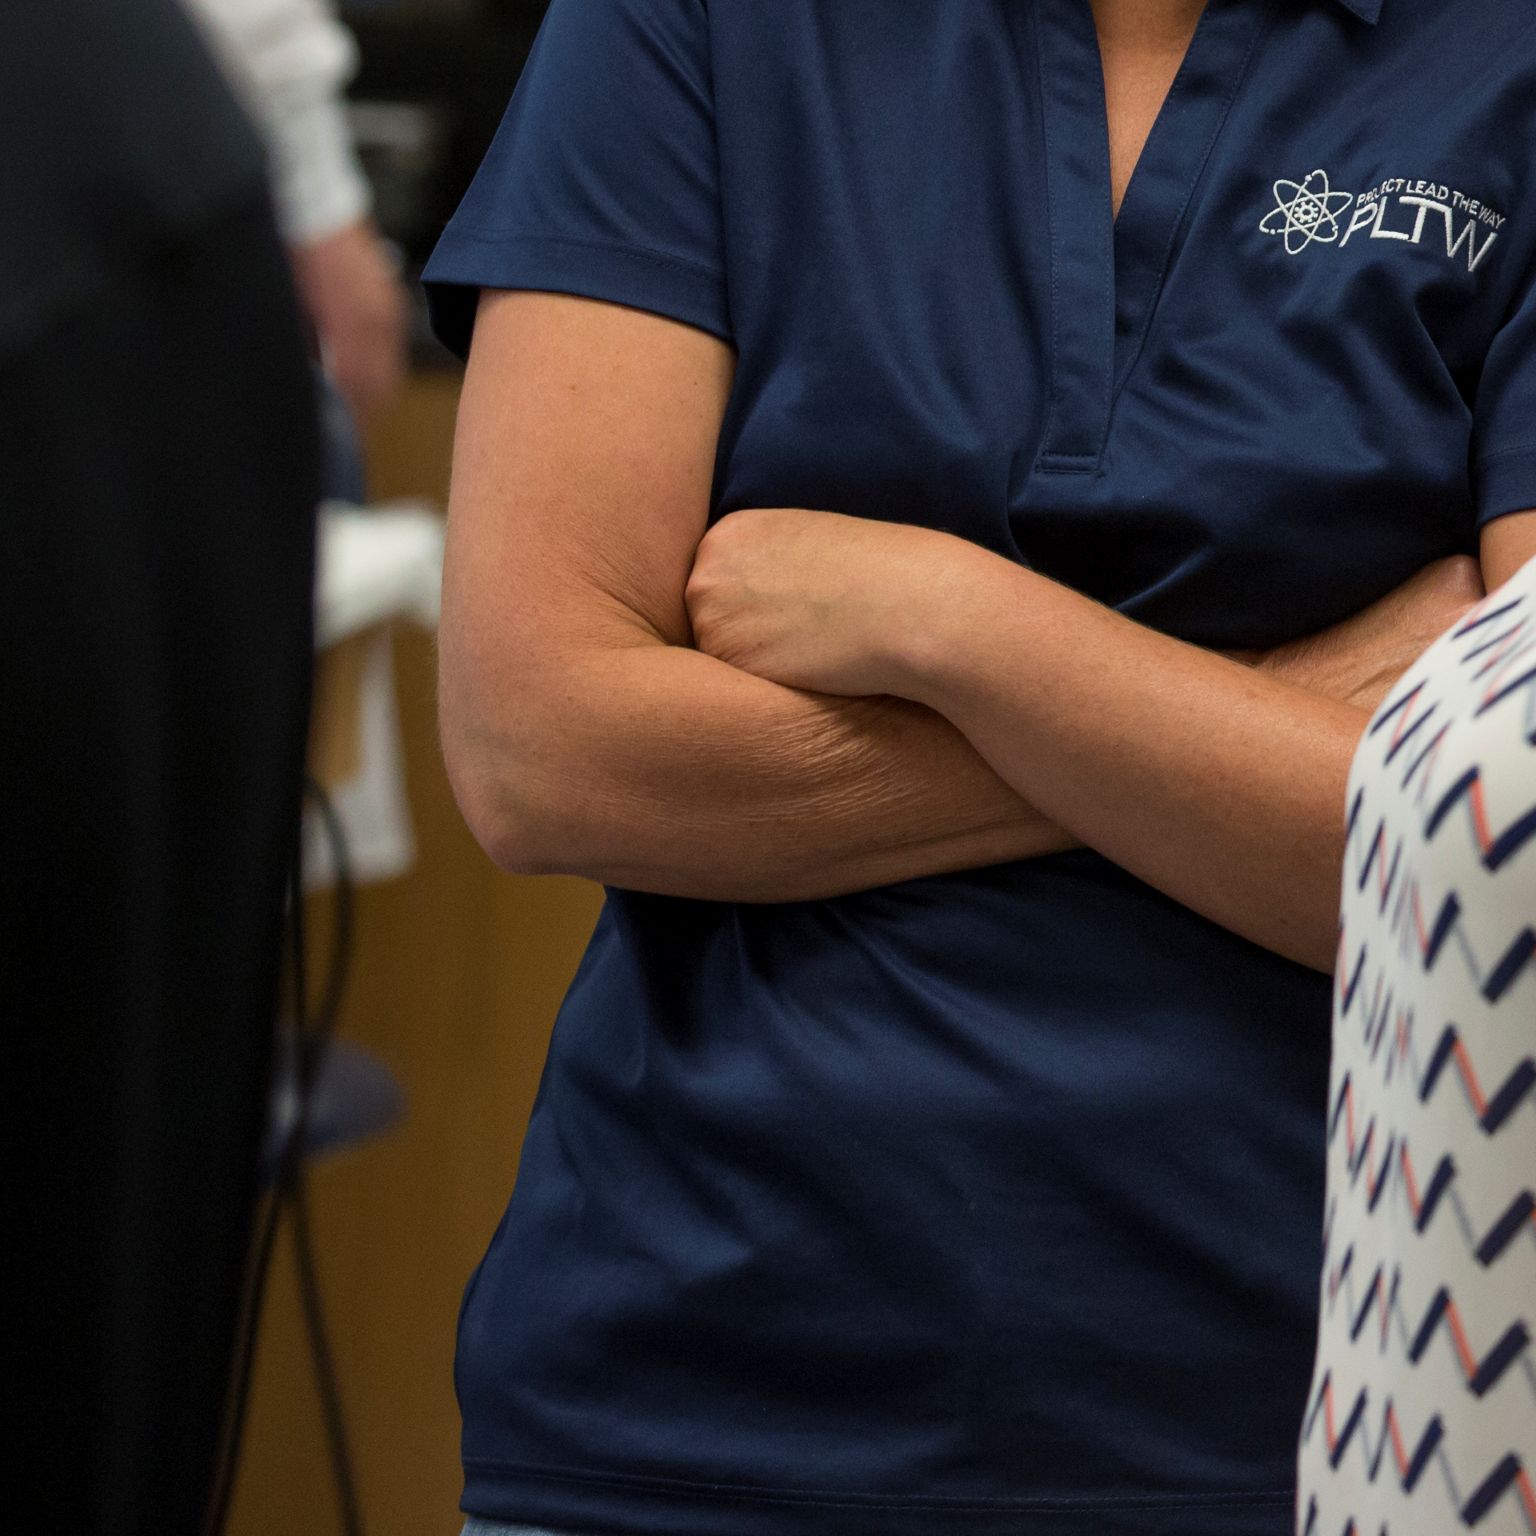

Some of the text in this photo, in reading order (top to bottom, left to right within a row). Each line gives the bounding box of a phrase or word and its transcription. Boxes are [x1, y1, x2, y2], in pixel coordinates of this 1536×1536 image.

[1338, 195, 1498, 272] PLTW
[1406, 180, 1449, 200] LEAD
[1452, 190, 1479, 215] THE
[1478, 204, 1506, 229] WAY
